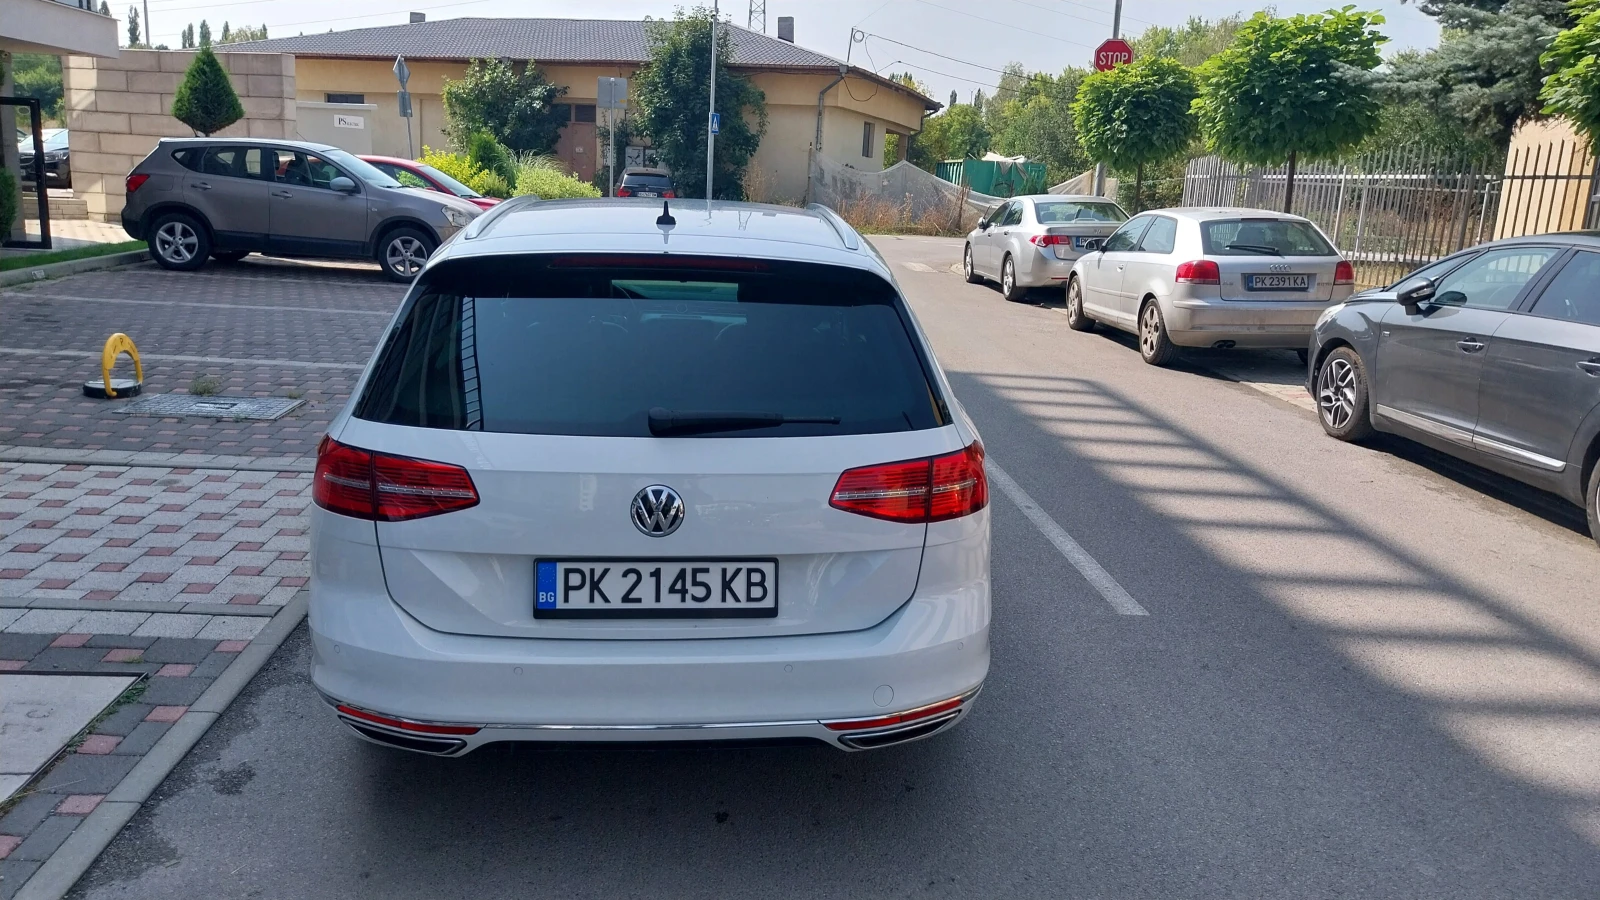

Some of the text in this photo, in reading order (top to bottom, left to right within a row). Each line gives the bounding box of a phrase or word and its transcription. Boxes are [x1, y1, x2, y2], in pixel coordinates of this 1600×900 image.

[1099, 51, 1129, 66] STOP
[338, 117, 347, 125] PS
[1254, 276, 1267, 287] PK
[1269, 276, 1291, 287] 2391
[1293, 276, 1306, 287] KA
[539, 567, 768, 604] BG PK 2145 KB
